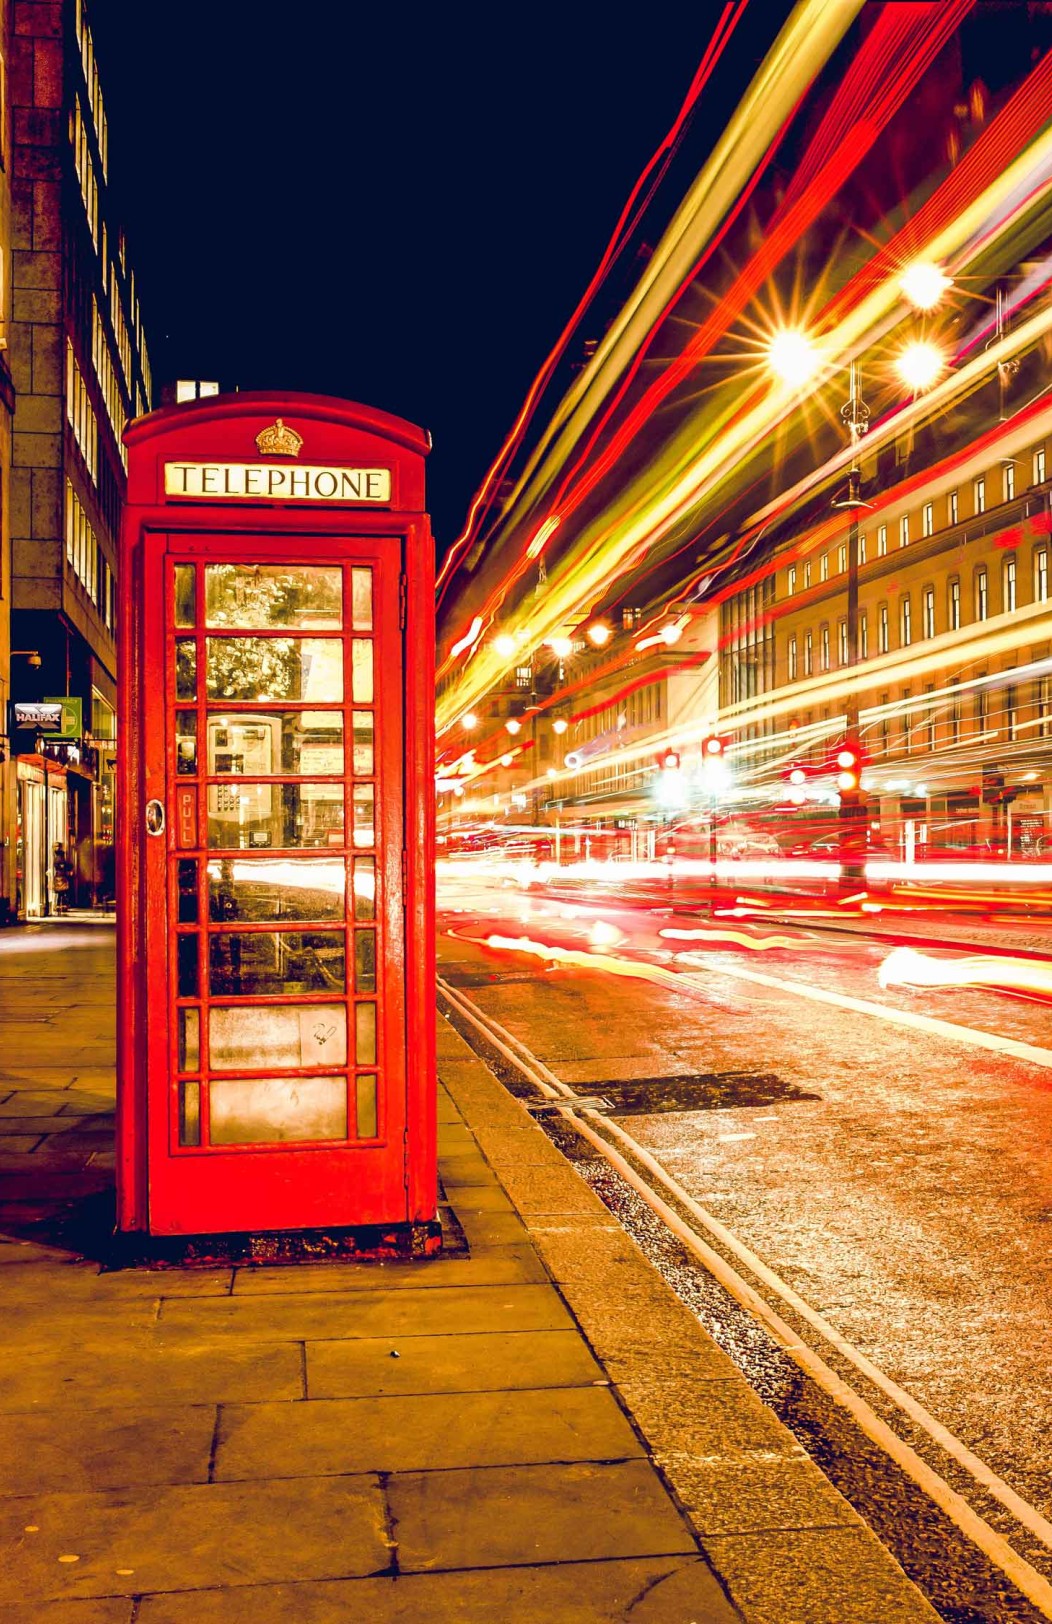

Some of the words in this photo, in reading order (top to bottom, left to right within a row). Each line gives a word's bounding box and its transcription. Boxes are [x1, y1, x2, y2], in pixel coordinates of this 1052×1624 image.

[174, 466, 382, 498] TELEPHONE
[16, 713, 60, 722] HALIFAX
[183, 795, 191, 841] PULL
